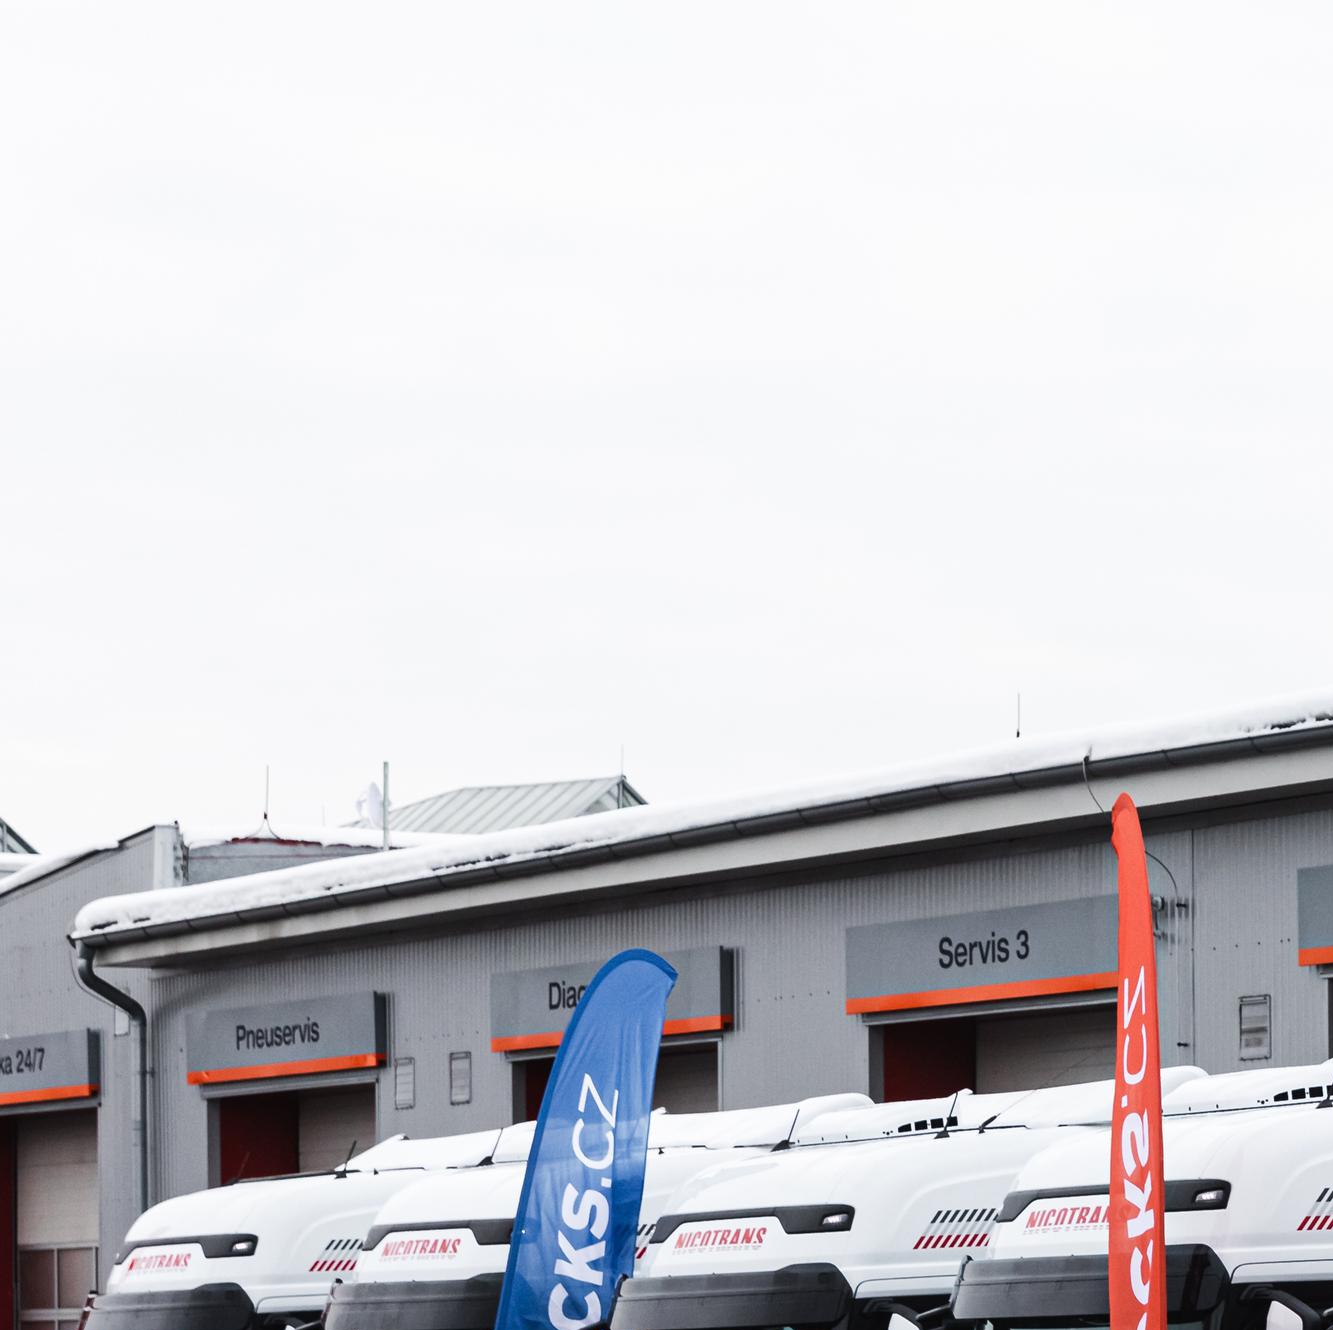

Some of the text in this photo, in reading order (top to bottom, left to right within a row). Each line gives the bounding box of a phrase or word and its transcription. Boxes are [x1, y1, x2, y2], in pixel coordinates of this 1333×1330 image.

[939, 929, 1030, 969] Servis 3
[235, 1018, 320, 1051] Pneuservis
[16, 1047, 45, 1073] 24/7
[381, 1238, 462, 1261] NICOTRANS
[673, 1227, 767, 1254] NICOTRANS
